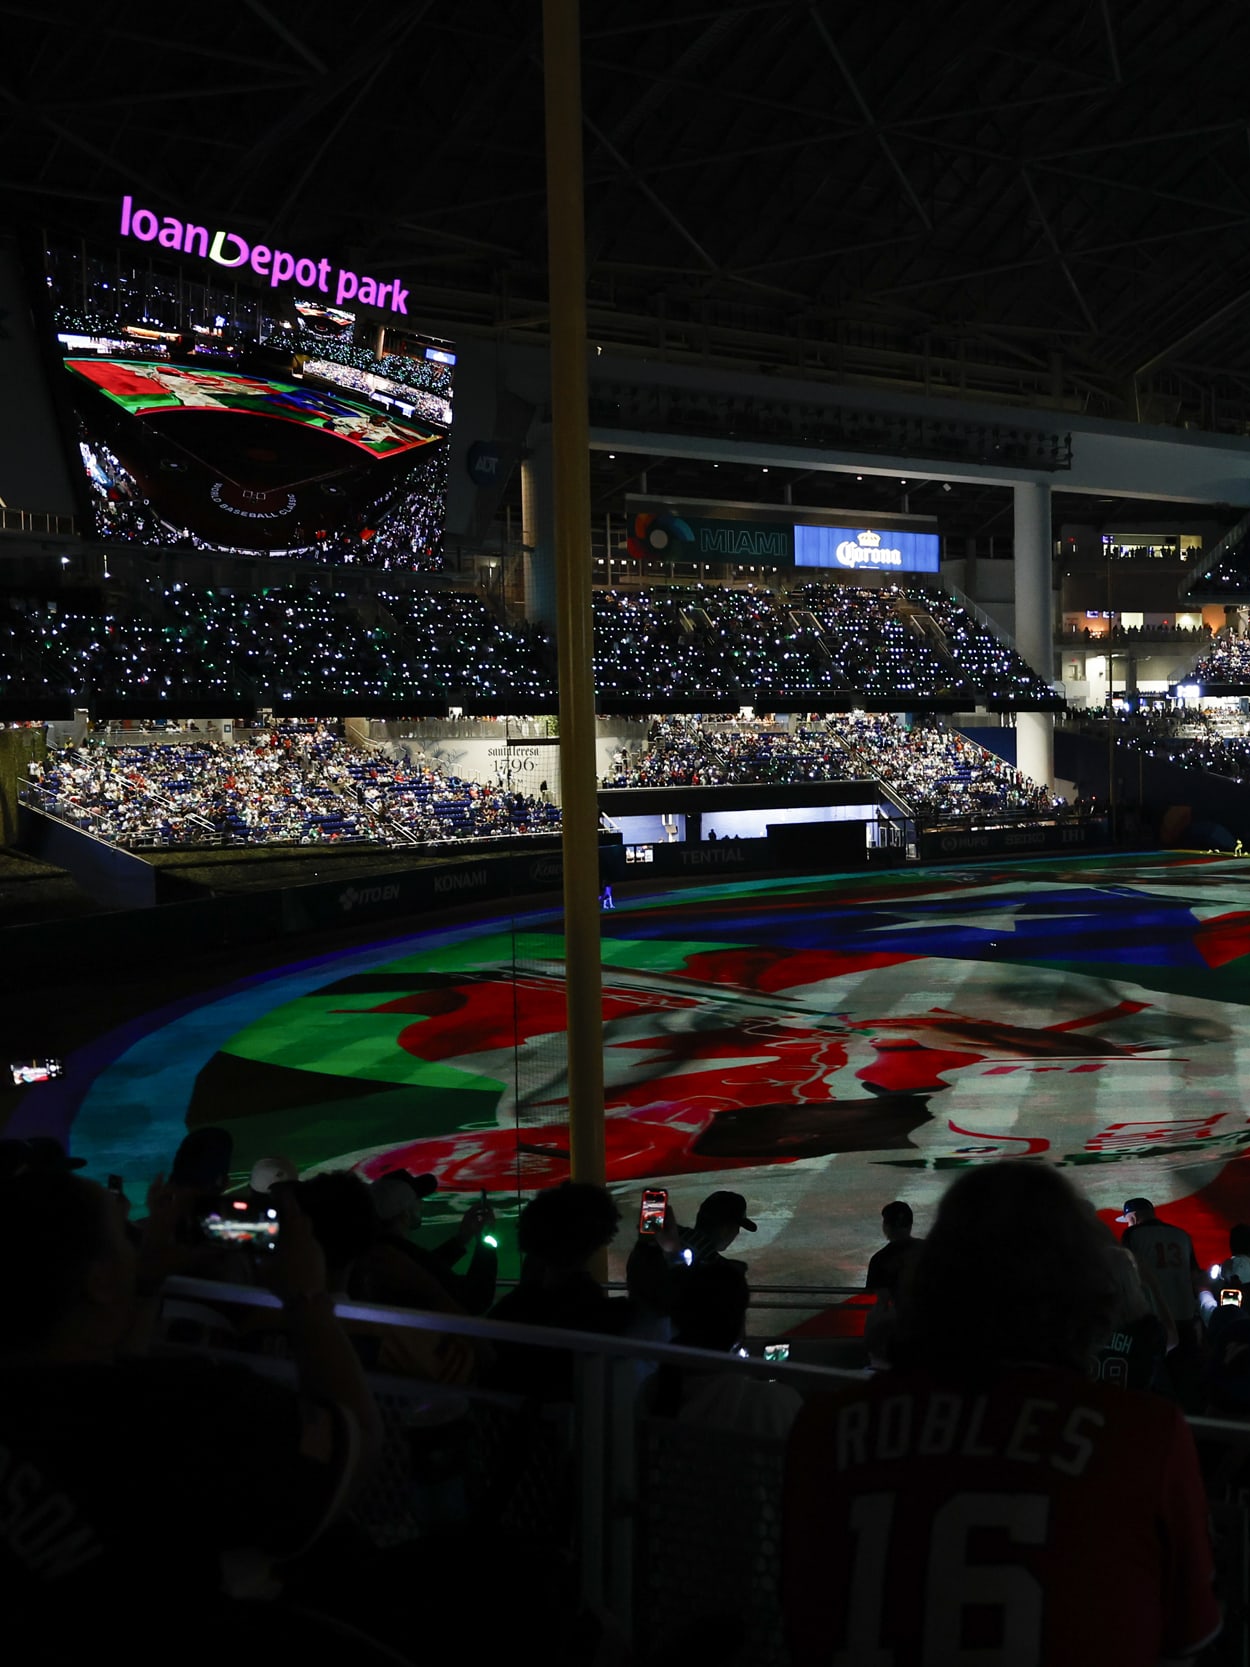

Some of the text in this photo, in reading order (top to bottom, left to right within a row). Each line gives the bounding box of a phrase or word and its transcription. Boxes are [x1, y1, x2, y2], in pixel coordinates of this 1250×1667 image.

[119, 194, 411, 316] loanDepot park
[474, 455, 499, 476] ADT
[700, 527, 788, 557] MIAMI
[835, 540, 902, 568] Corona
[680, 848, 744, 865] TENTIAL
[433, 869, 488, 893] KONAMI
[1155, 1242, 1183, 1269] 13
[835, 1391, 1106, 1479] ROBLES
[831, 1488, 1051, 1667] 16
